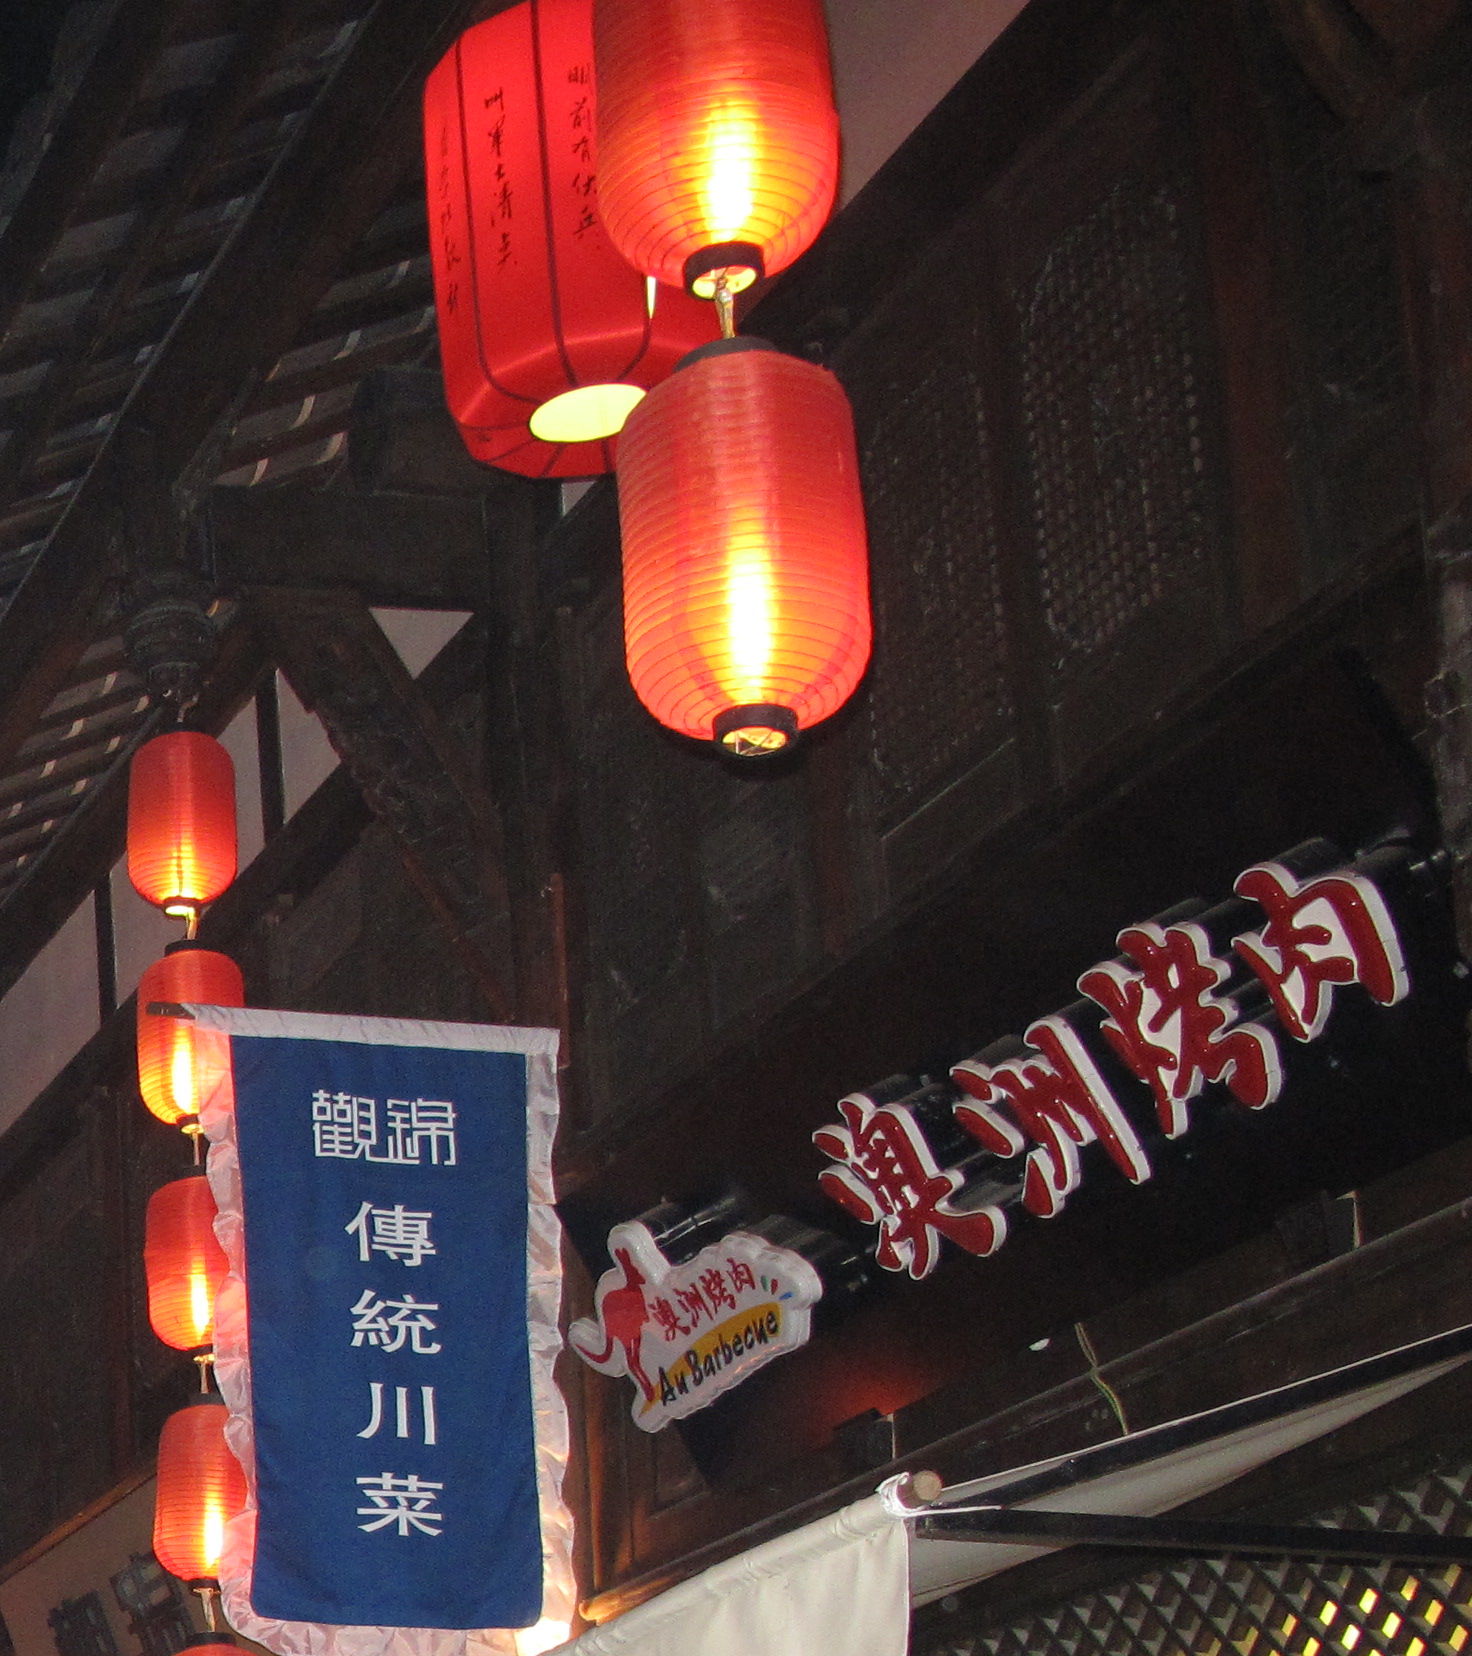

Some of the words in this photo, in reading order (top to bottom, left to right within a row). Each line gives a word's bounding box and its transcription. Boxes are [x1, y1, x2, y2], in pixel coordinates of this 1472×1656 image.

[811, 860, 1410, 1281] 澳洲烤肉
[345, 1201, 444, 1537] 傳統川菜
[690, 1307, 780, 1389] Barbecue
